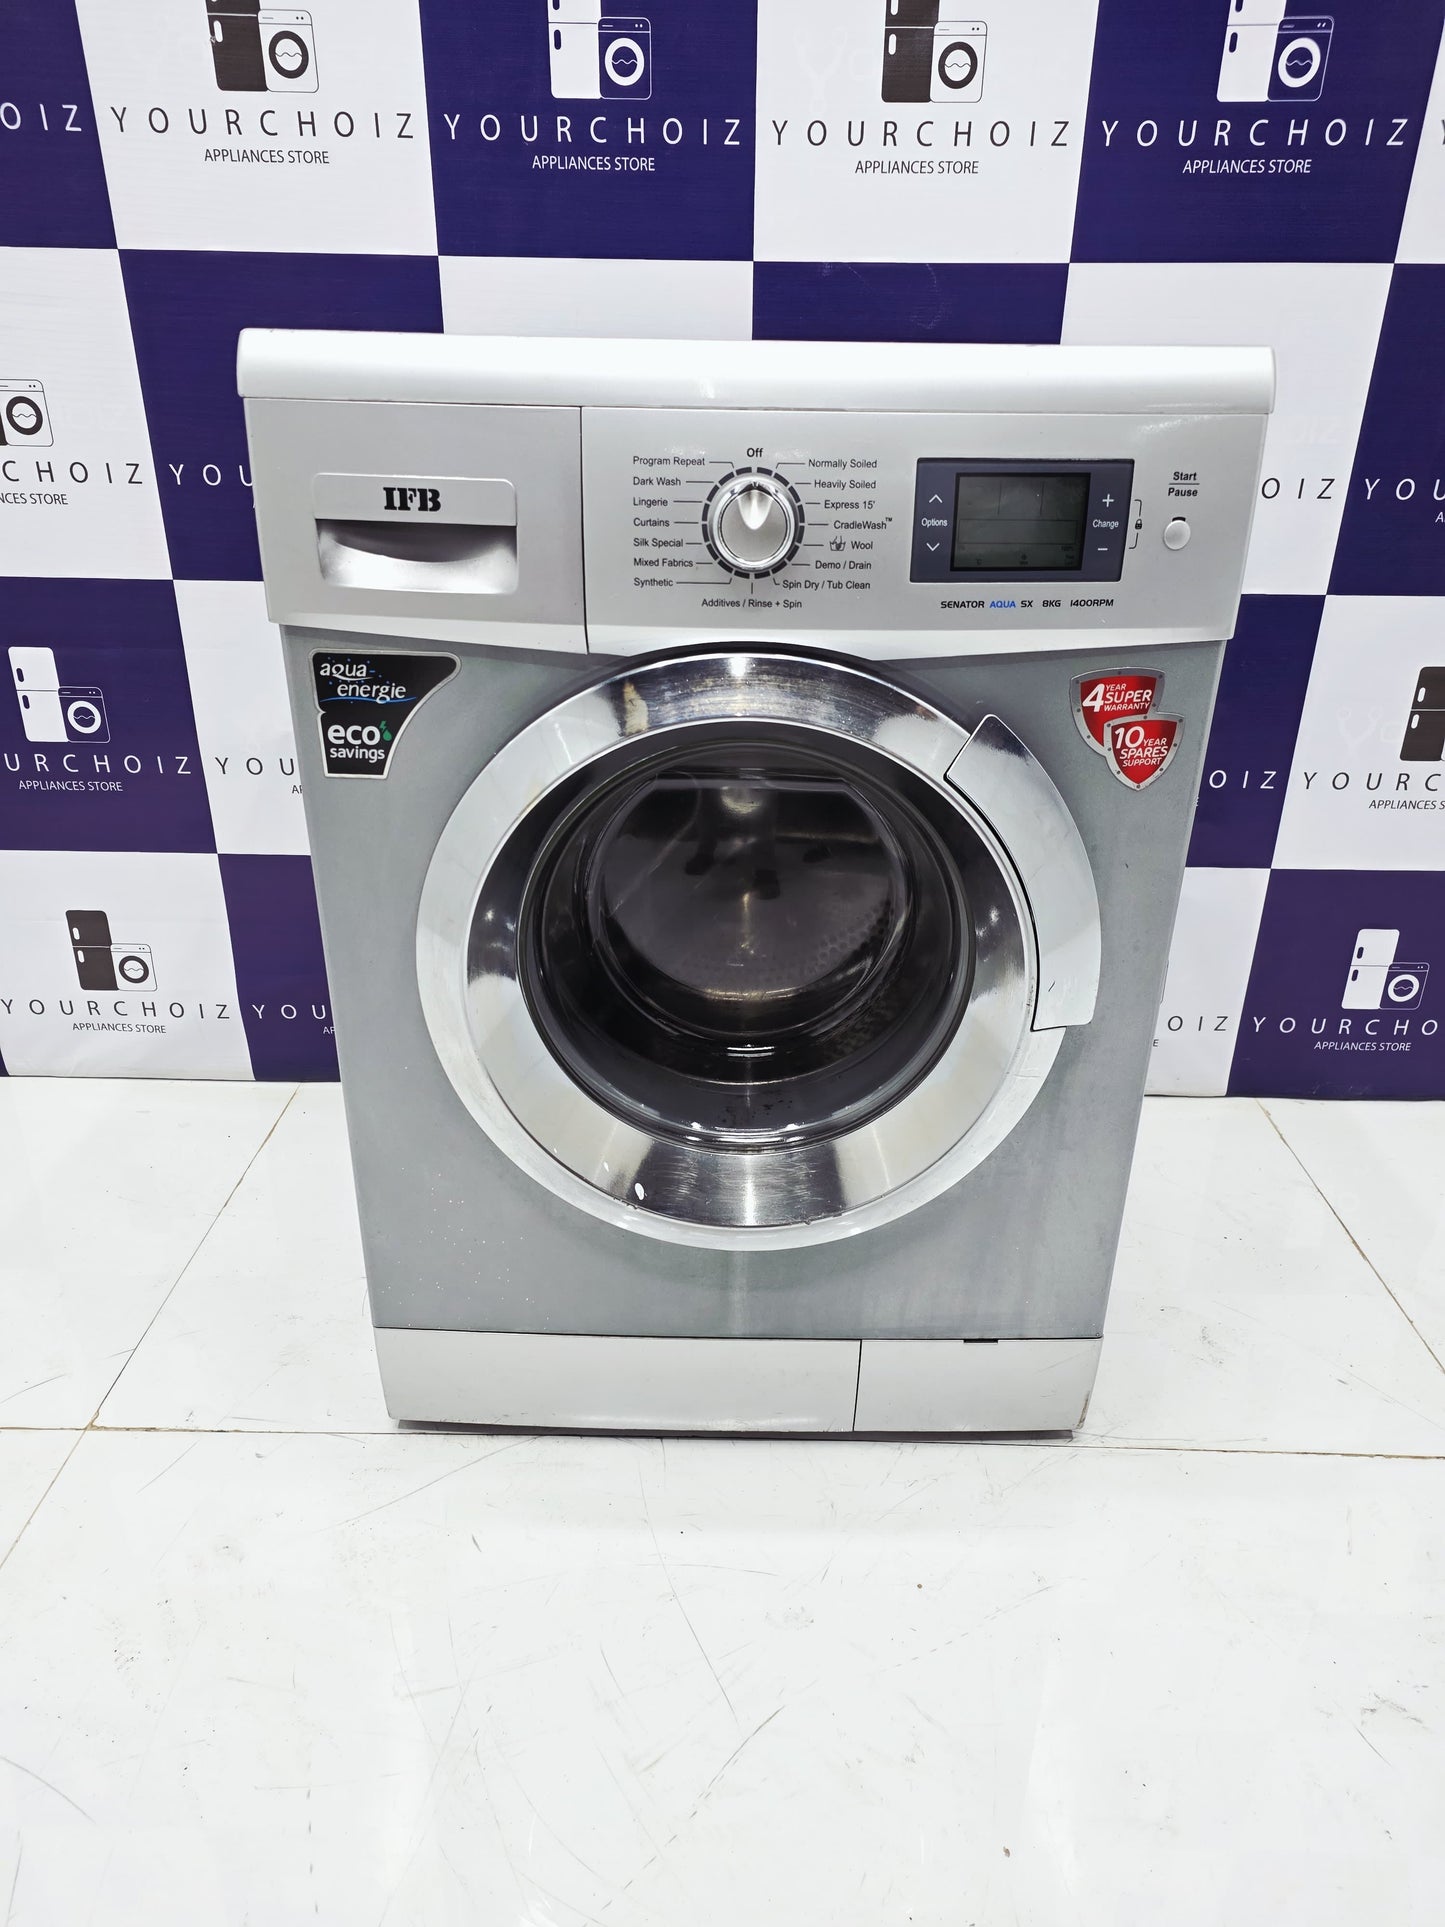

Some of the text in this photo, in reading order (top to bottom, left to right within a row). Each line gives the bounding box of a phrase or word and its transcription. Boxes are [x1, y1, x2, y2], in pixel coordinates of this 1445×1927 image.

[111, 107, 413, 138] YOURCHOIZ
[444, 114, 739, 145] YOURCHOIZ
[772, 120, 1069, 146] YOURCHOIZ
[1102, 119, 1408, 146] YOURCHOIZ
[205, 149, 329, 164] APPLIANCES STORE
[533, 156, 655, 171] APPLIANCES STORE
[855, 160, 978, 174] APPLIANCES STORE
[1183, 159, 1312, 173] APPLIANCES STORE
[747, 448, 763, 457] Off
[633, 456, 705, 467] Program Repeat
[809, 459, 877, 470] Normally Soiled
[633, 477, 681, 486] Dark Wash
[1173, 472, 1196, 480] Start
[815, 480, 876, 490] Heavily Soiled
[1168, 488, 1197, 496] Pause
[30, 493, 68, 504] STORE
[383, 487, 441, 511] IFB
[633, 498, 668, 508] Lingerie
[825, 500, 859, 510] Express
[634, 518, 670, 527] Curtains
[922, 518, 947, 527] Options
[1093, 519, 1119, 529] Change
[634, 538, 683, 548] Silk Special
[851, 541, 873, 549] Wool
[634, 558, 693, 567] Mixed Fabrics
[816, 560, 841, 569] Demo
[849, 561, 871, 569] Drain
[634, 577, 673, 588] Synthetic
[783, 580, 801, 590] Spin
[805, 580, 819, 591] Dry
[827, 580, 843, 589] Tub
[846, 581, 870, 589] Clean
[702, 599, 740, 607] Additives
[748, 599, 772, 607] Rinse
[783, 600, 802, 609] Spin
[319, 662, 373, 681] aqua
[337, 683, 406, 704] energie
[1082, 683, 1152, 712] 4 SUPER
[1104, 702, 1150, 711] WARRANTY
[328, 725, 380, 745] eco
[1115, 726, 1167, 749] 10 YEAR
[330, 746, 385, 763] savings
[1120, 746, 1168, 759] SPARES
[1122, 758, 1162, 767] SUPPORT
[19, 781, 123, 791] APPLIANCES STORE
[1369, 800, 1437, 809] APPLIANCES
[1, 999, 229, 1019] YOURCHOIZ
[73, 1023, 166, 1033] APPLIANCES STORE
[1314, 1042, 1411, 1051] APPLIANCES STORE
